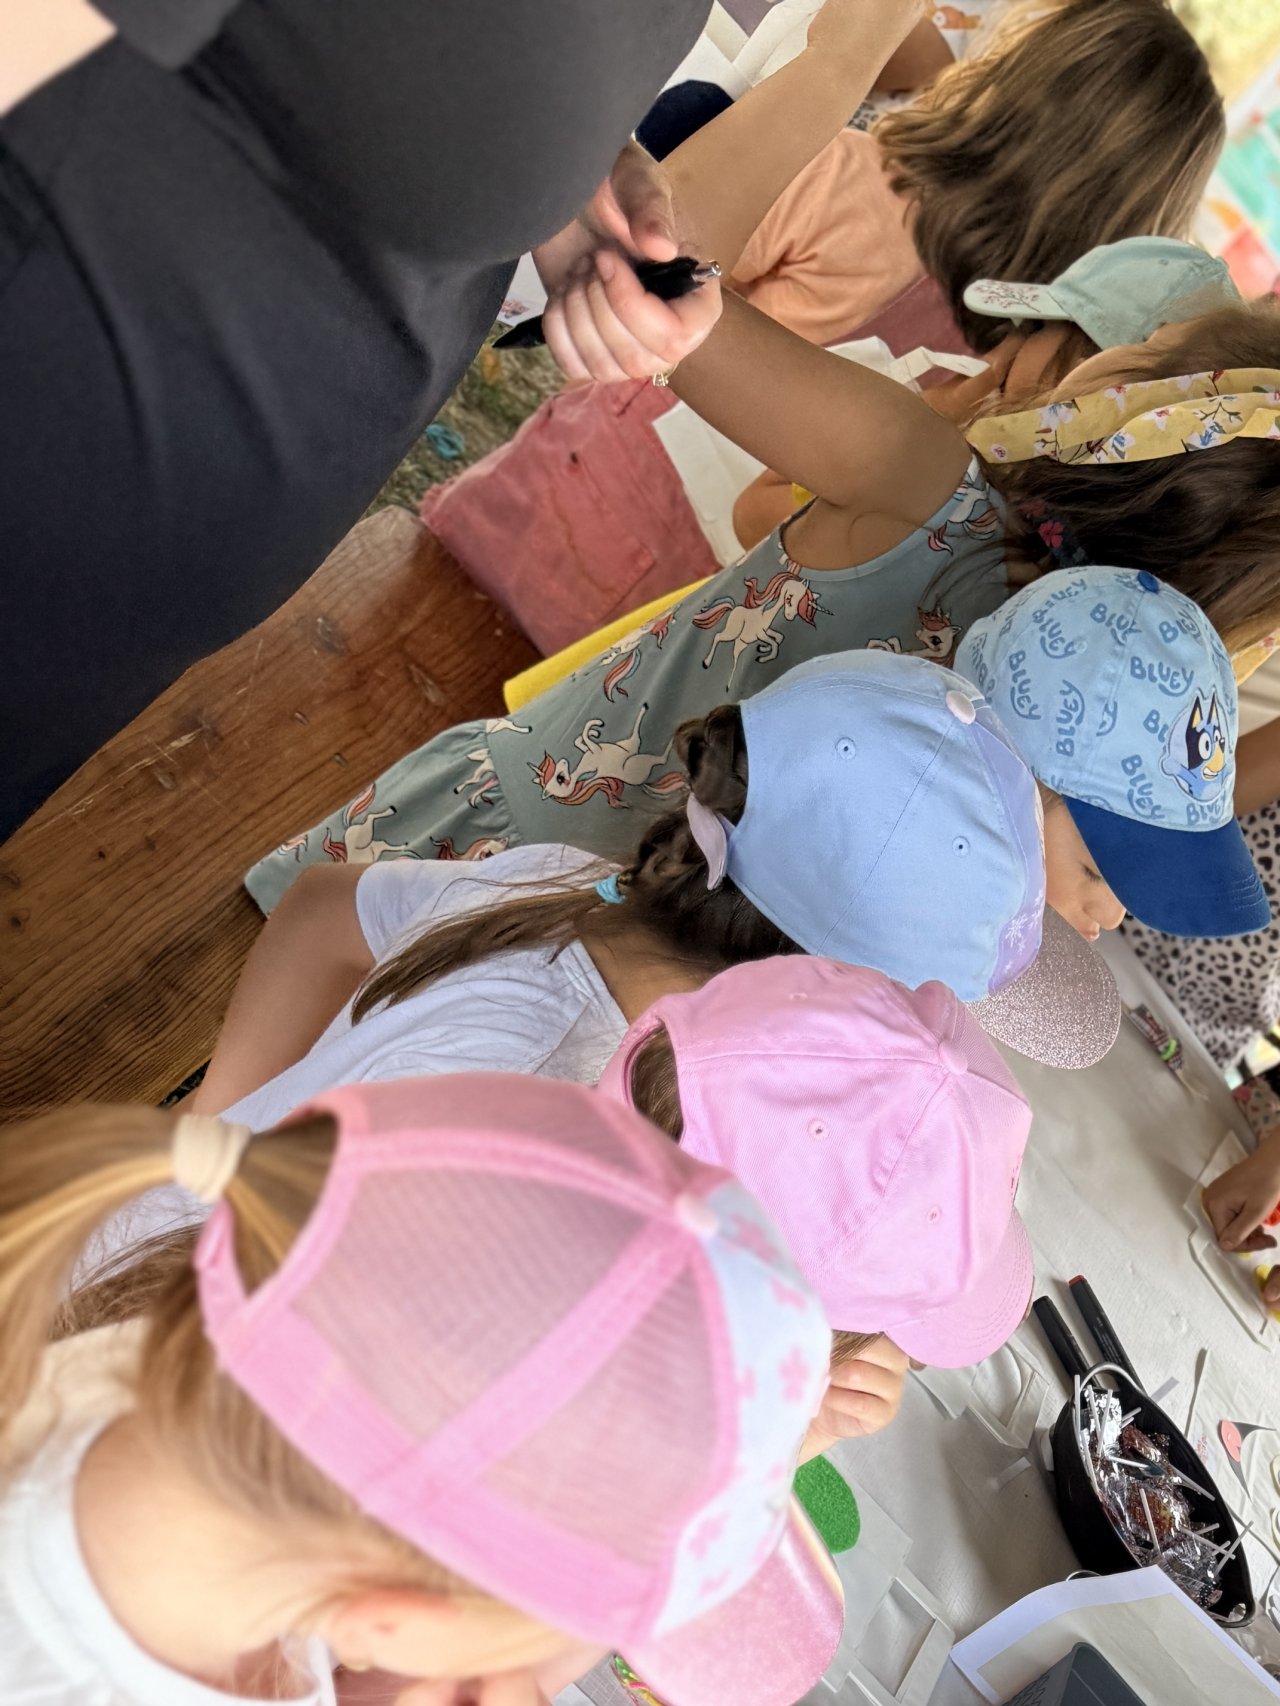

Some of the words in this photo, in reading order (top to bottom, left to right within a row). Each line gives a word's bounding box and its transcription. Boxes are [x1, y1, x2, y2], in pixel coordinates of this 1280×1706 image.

[1008, 650, 1043, 721] BLUEY
[1130, 655, 1195, 698] BLUEY
[1055, 679, 1086, 758] BLUEY
[1121, 754, 1166, 820] BLUEY
